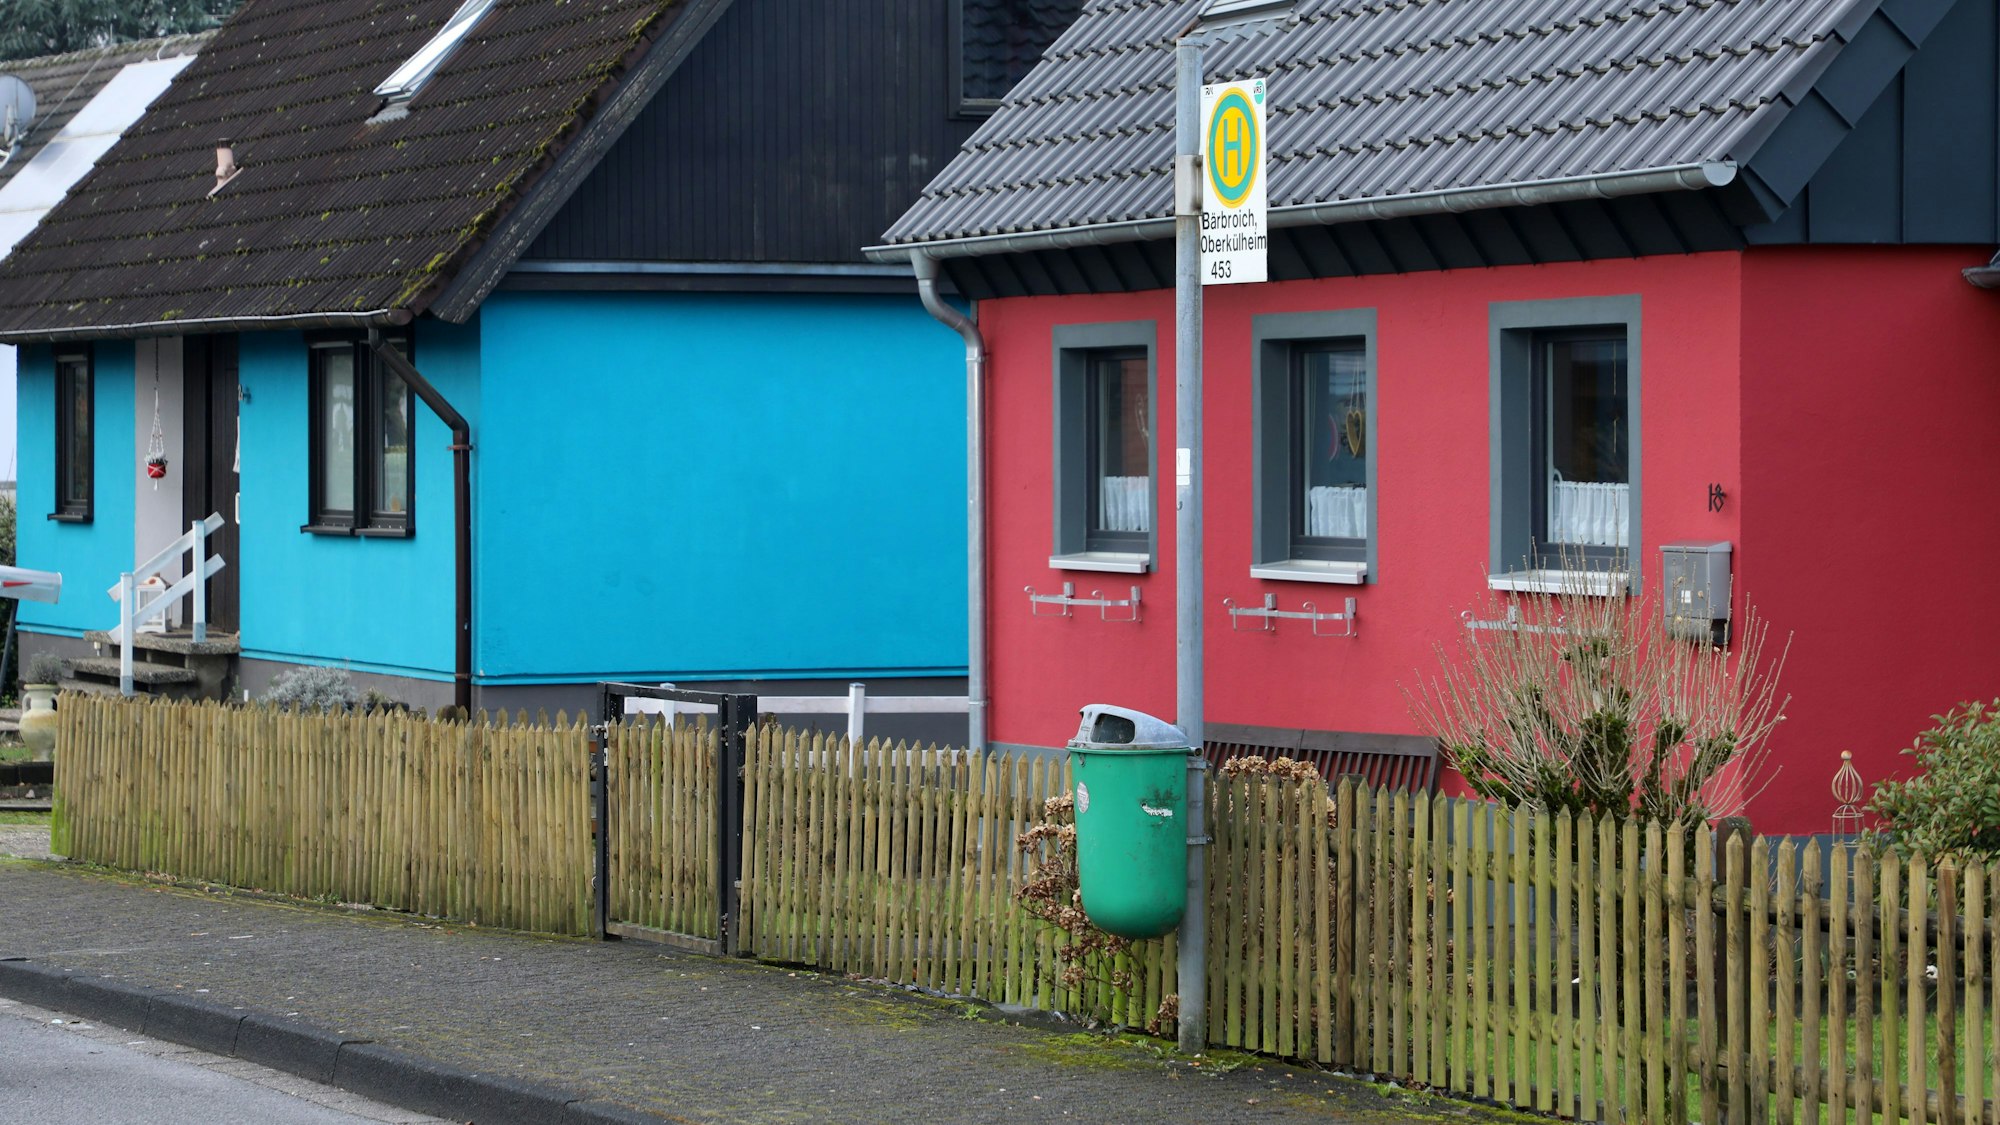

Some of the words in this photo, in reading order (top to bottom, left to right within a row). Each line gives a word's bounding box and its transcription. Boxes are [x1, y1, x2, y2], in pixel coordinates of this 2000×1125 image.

[1223, 117, 1242, 177] H
[1202, 208, 1257, 230] Bärbroich,
[1200, 231, 1267, 253] Oberkülheim
[1211, 260, 1232, 279] 453
